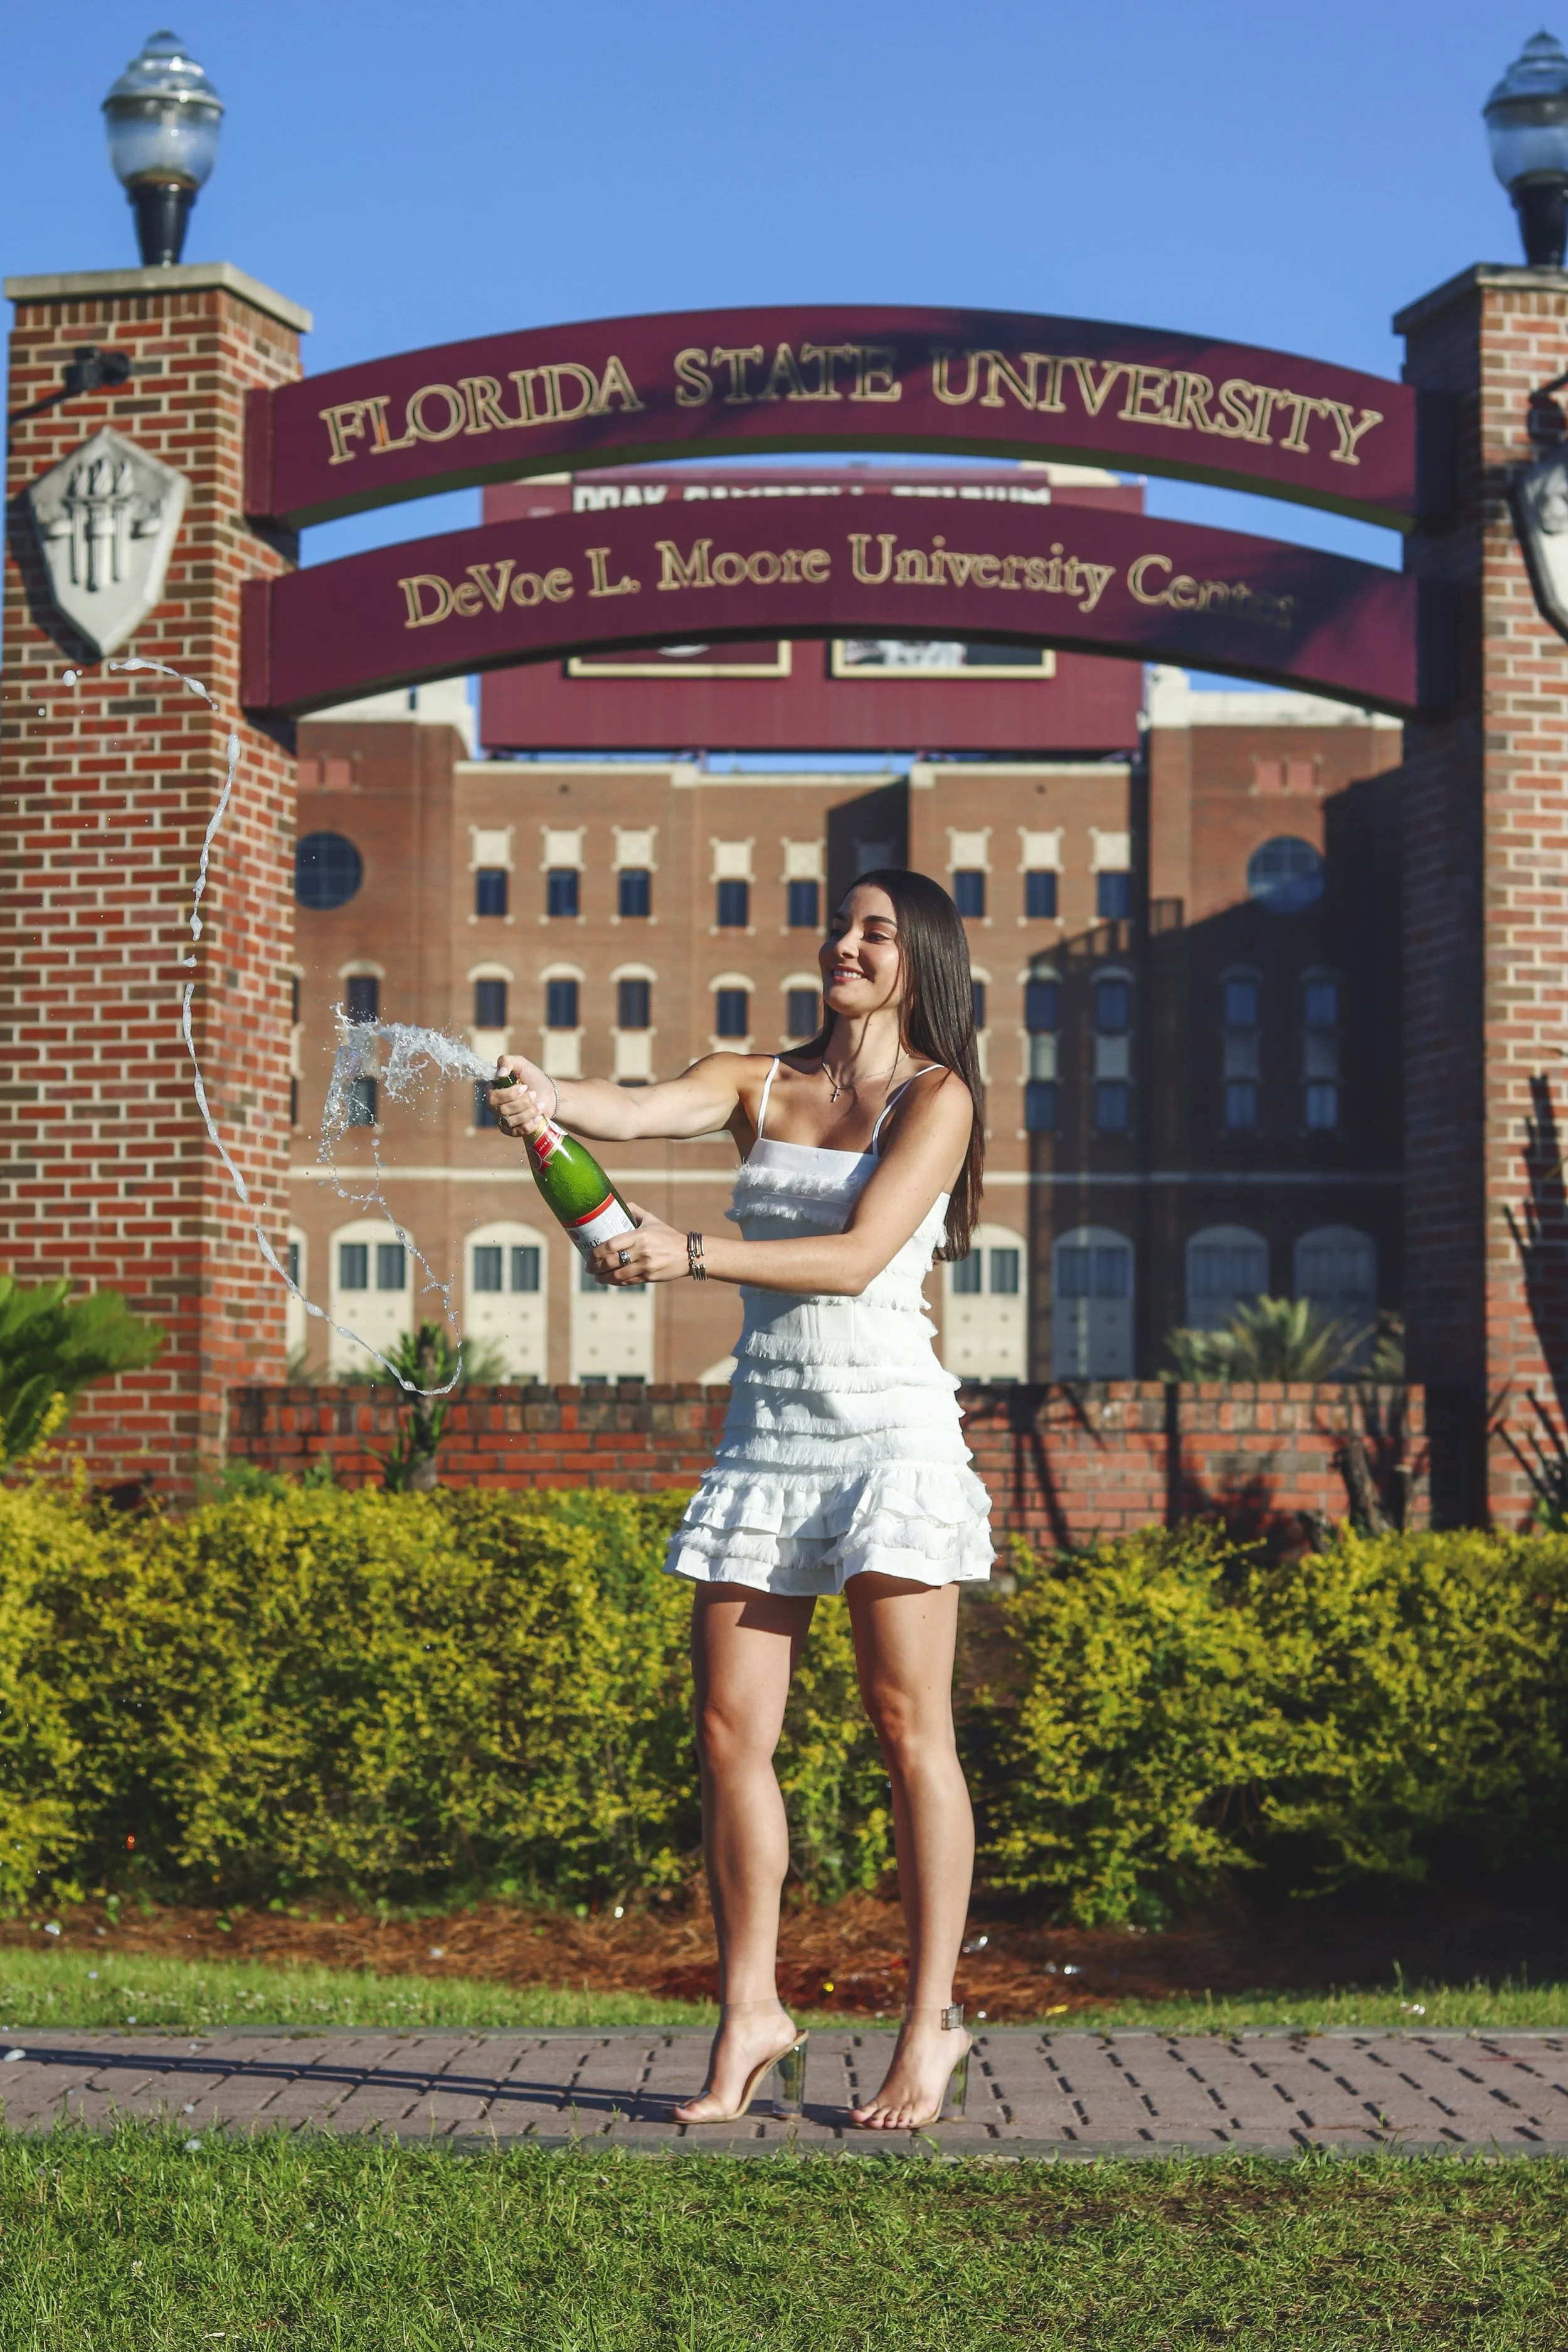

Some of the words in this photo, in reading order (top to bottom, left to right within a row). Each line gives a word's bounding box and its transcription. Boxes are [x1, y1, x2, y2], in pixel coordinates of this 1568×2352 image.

[319, 355, 644, 465] FLORIDA
[674, 343, 903, 407] STATE
[932, 347, 1384, 465] UNIVERSITY
[398, 559, 575, 628] DeVoe
[586, 547, 641, 597] L.
[656, 538, 832, 591] Moore
[848, 533, 1116, 613] University
